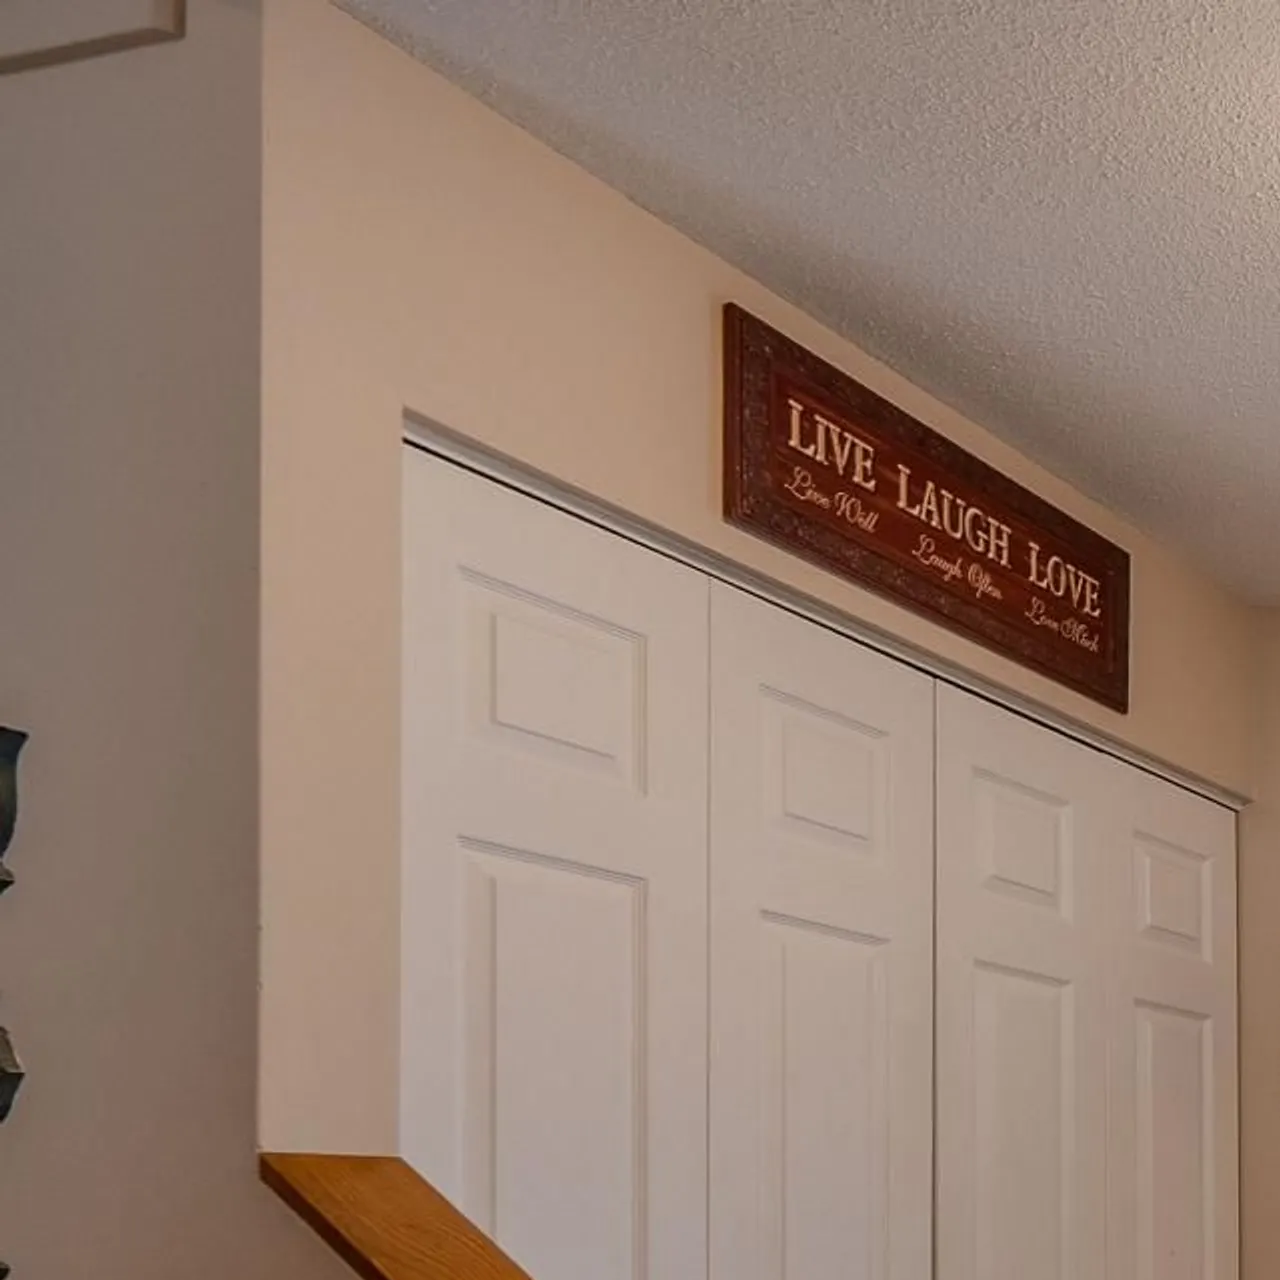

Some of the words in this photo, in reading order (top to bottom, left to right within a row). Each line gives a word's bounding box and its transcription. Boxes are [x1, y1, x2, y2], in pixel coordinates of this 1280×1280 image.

[787, 400, 877, 492] LIVE
[897, 464, 1012, 570] LAUGH
[1027, 542, 1101, 617] LOVE
[911, 534, 962, 582] Laugh
